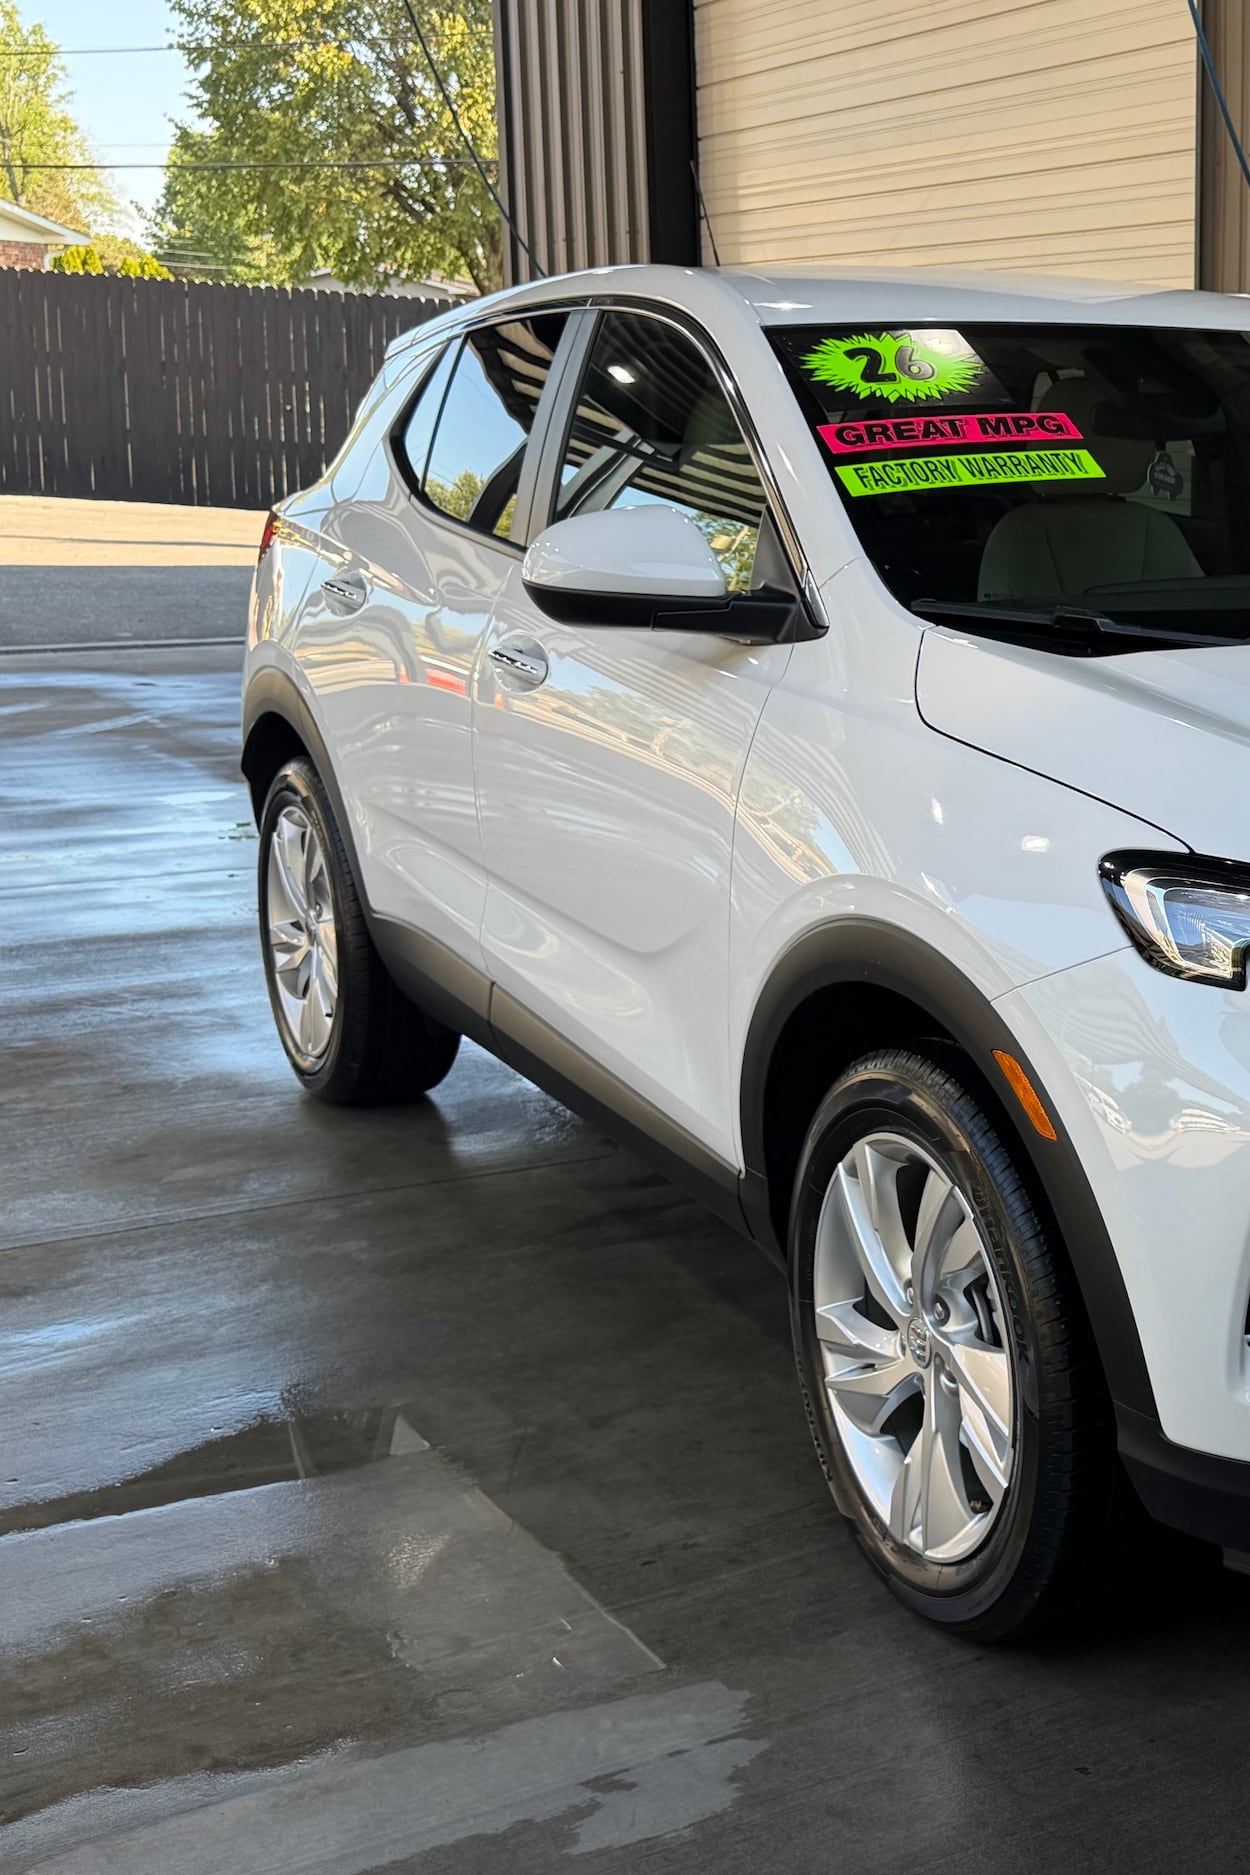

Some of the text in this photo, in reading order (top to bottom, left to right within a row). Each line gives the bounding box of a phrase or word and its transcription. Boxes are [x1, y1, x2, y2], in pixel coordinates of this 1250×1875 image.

[843, 345, 936, 384] 26
[834, 414, 1067, 447] GREAT MPG
[852, 450, 1084, 491] FACTORY WARRANTY
